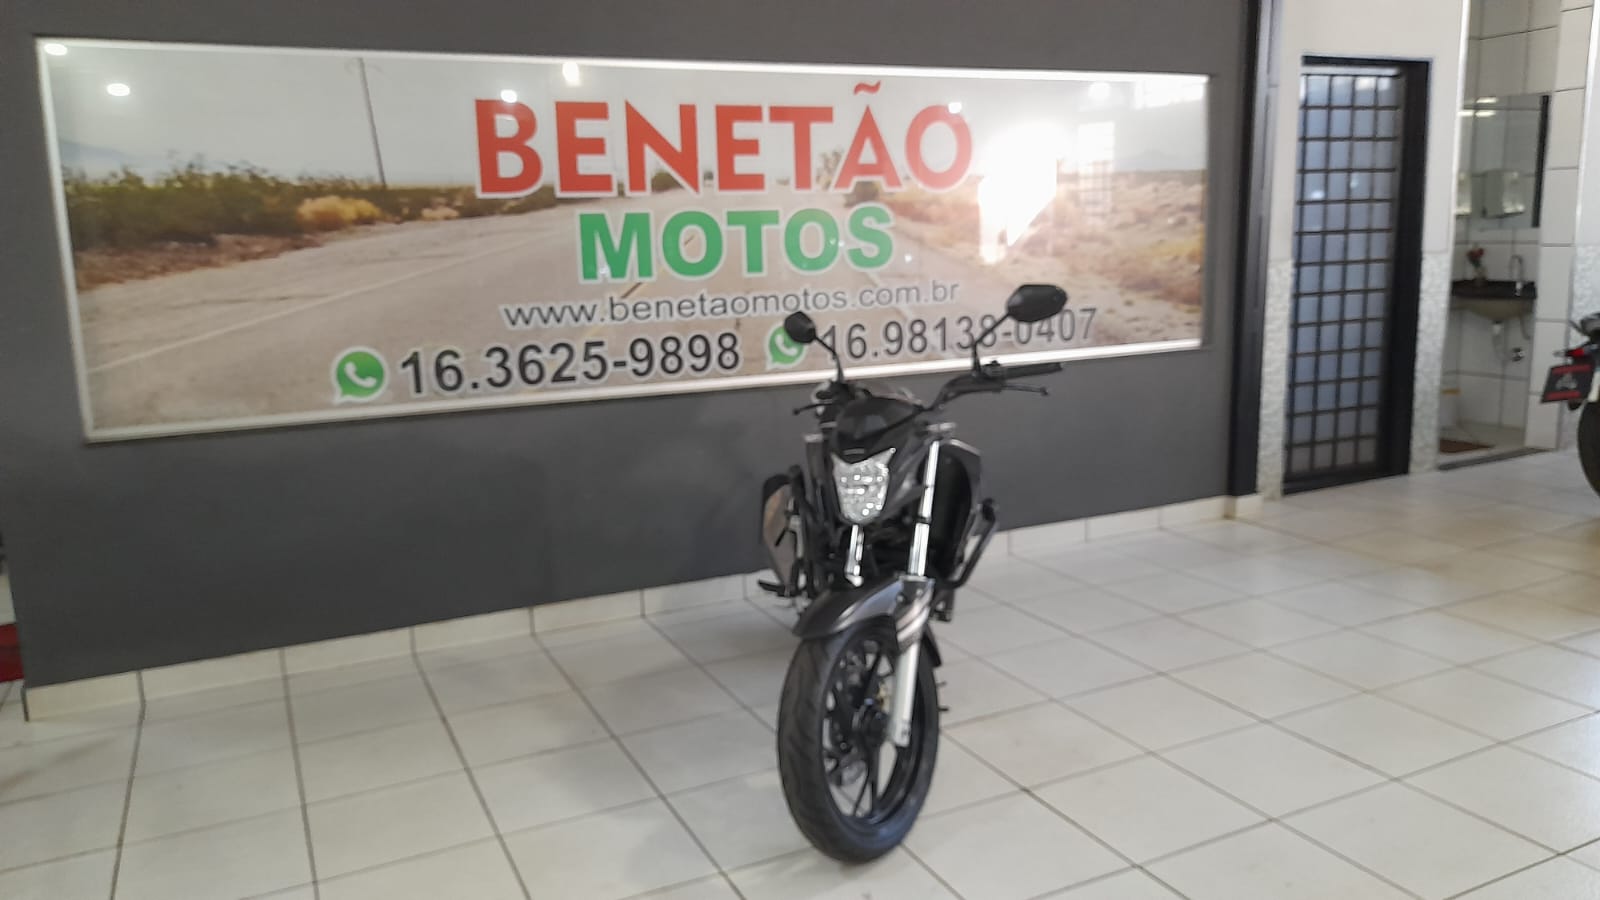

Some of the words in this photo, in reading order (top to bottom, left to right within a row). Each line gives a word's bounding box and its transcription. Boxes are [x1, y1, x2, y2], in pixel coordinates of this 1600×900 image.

[474, 80, 973, 195] BENETÃO
[579, 205, 894, 281] MOTOS
[503, 281, 960, 327] www.benetaomotos.com.br
[401, 332, 740, 394] 16.3625-9898
